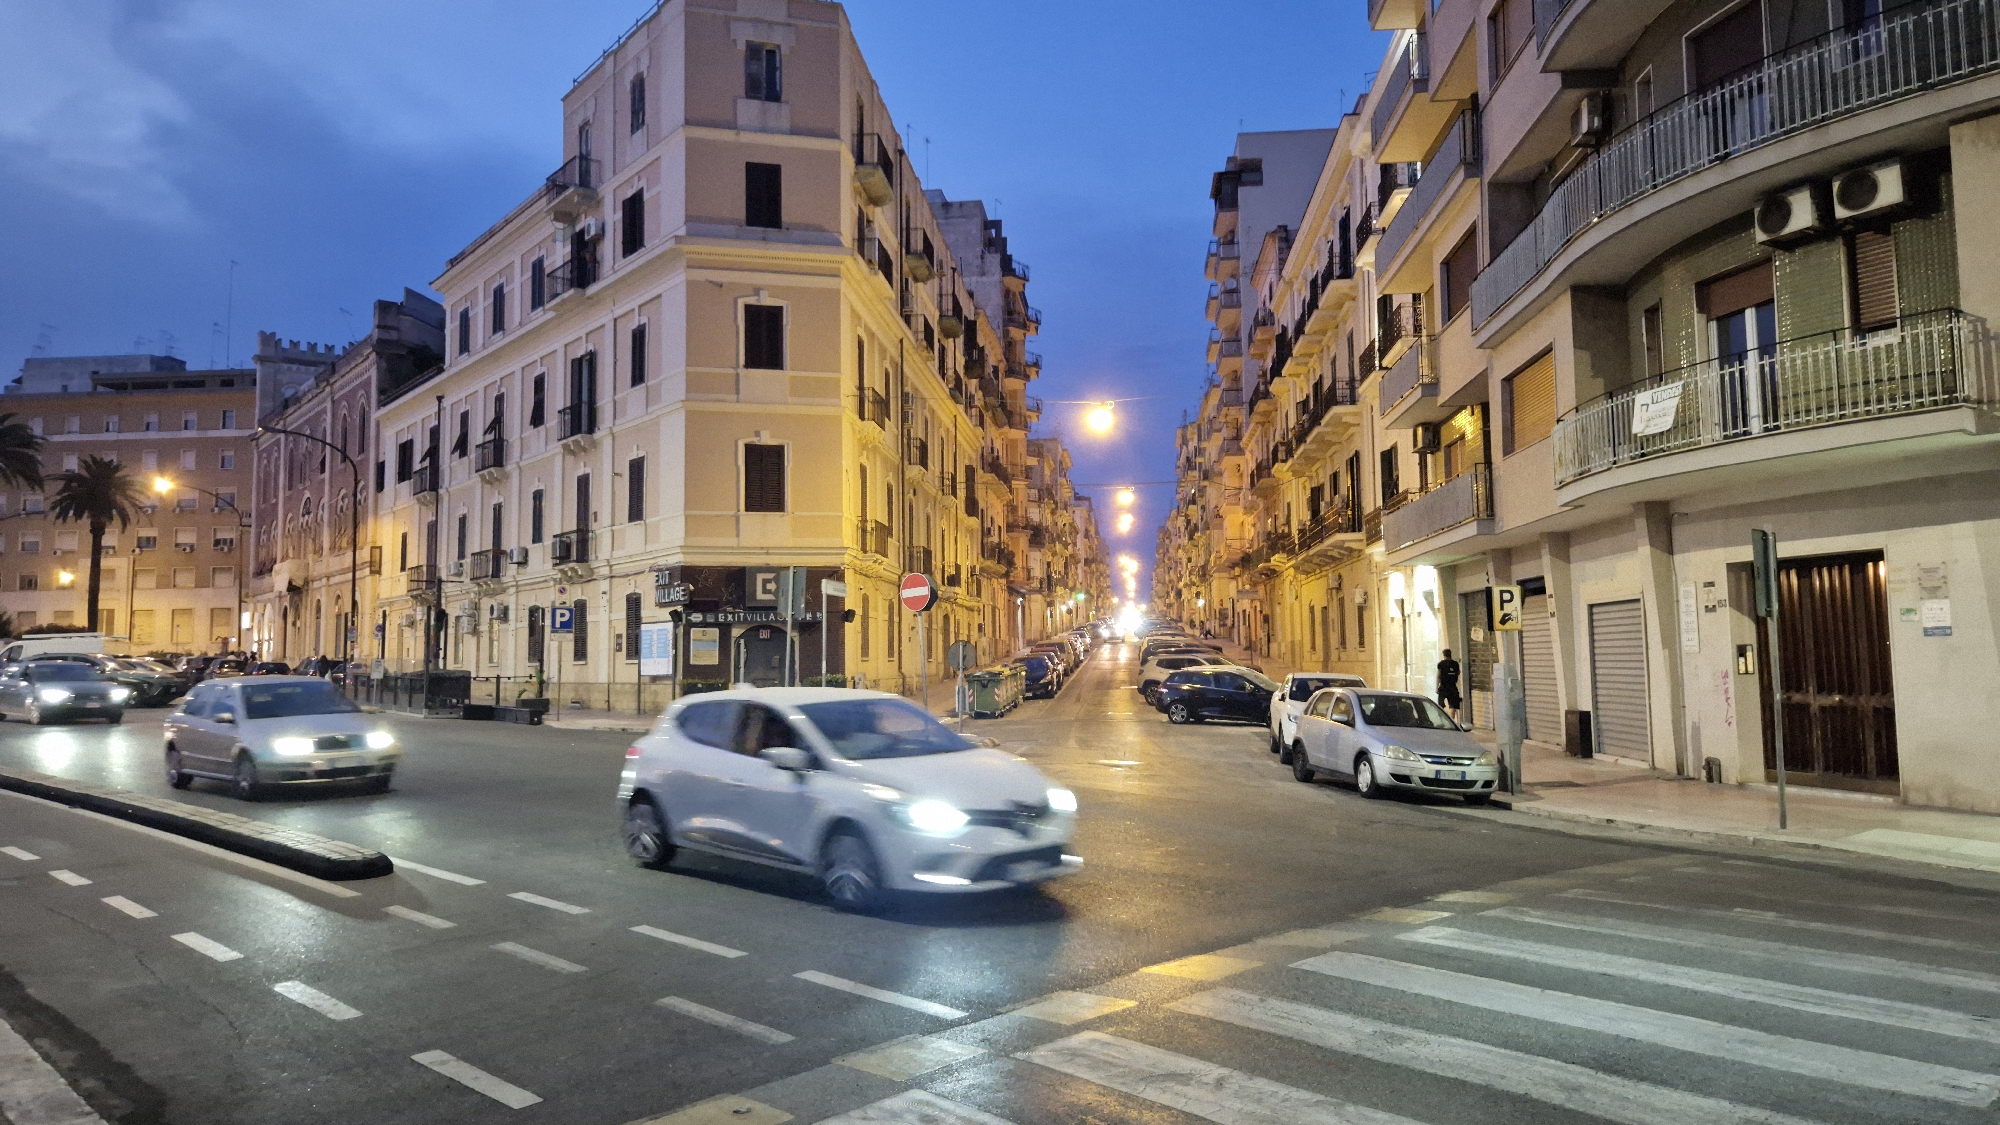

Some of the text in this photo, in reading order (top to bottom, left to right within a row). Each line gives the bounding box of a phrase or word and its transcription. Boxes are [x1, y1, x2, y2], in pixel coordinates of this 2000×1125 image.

[655, 570, 669, 586] EXIT
[656, 586, 685, 603] VILLAGE
[1499, 589, 1514, 611] P
[555, 608, 570, 628] P
[759, 629, 771, 639] EXIT
